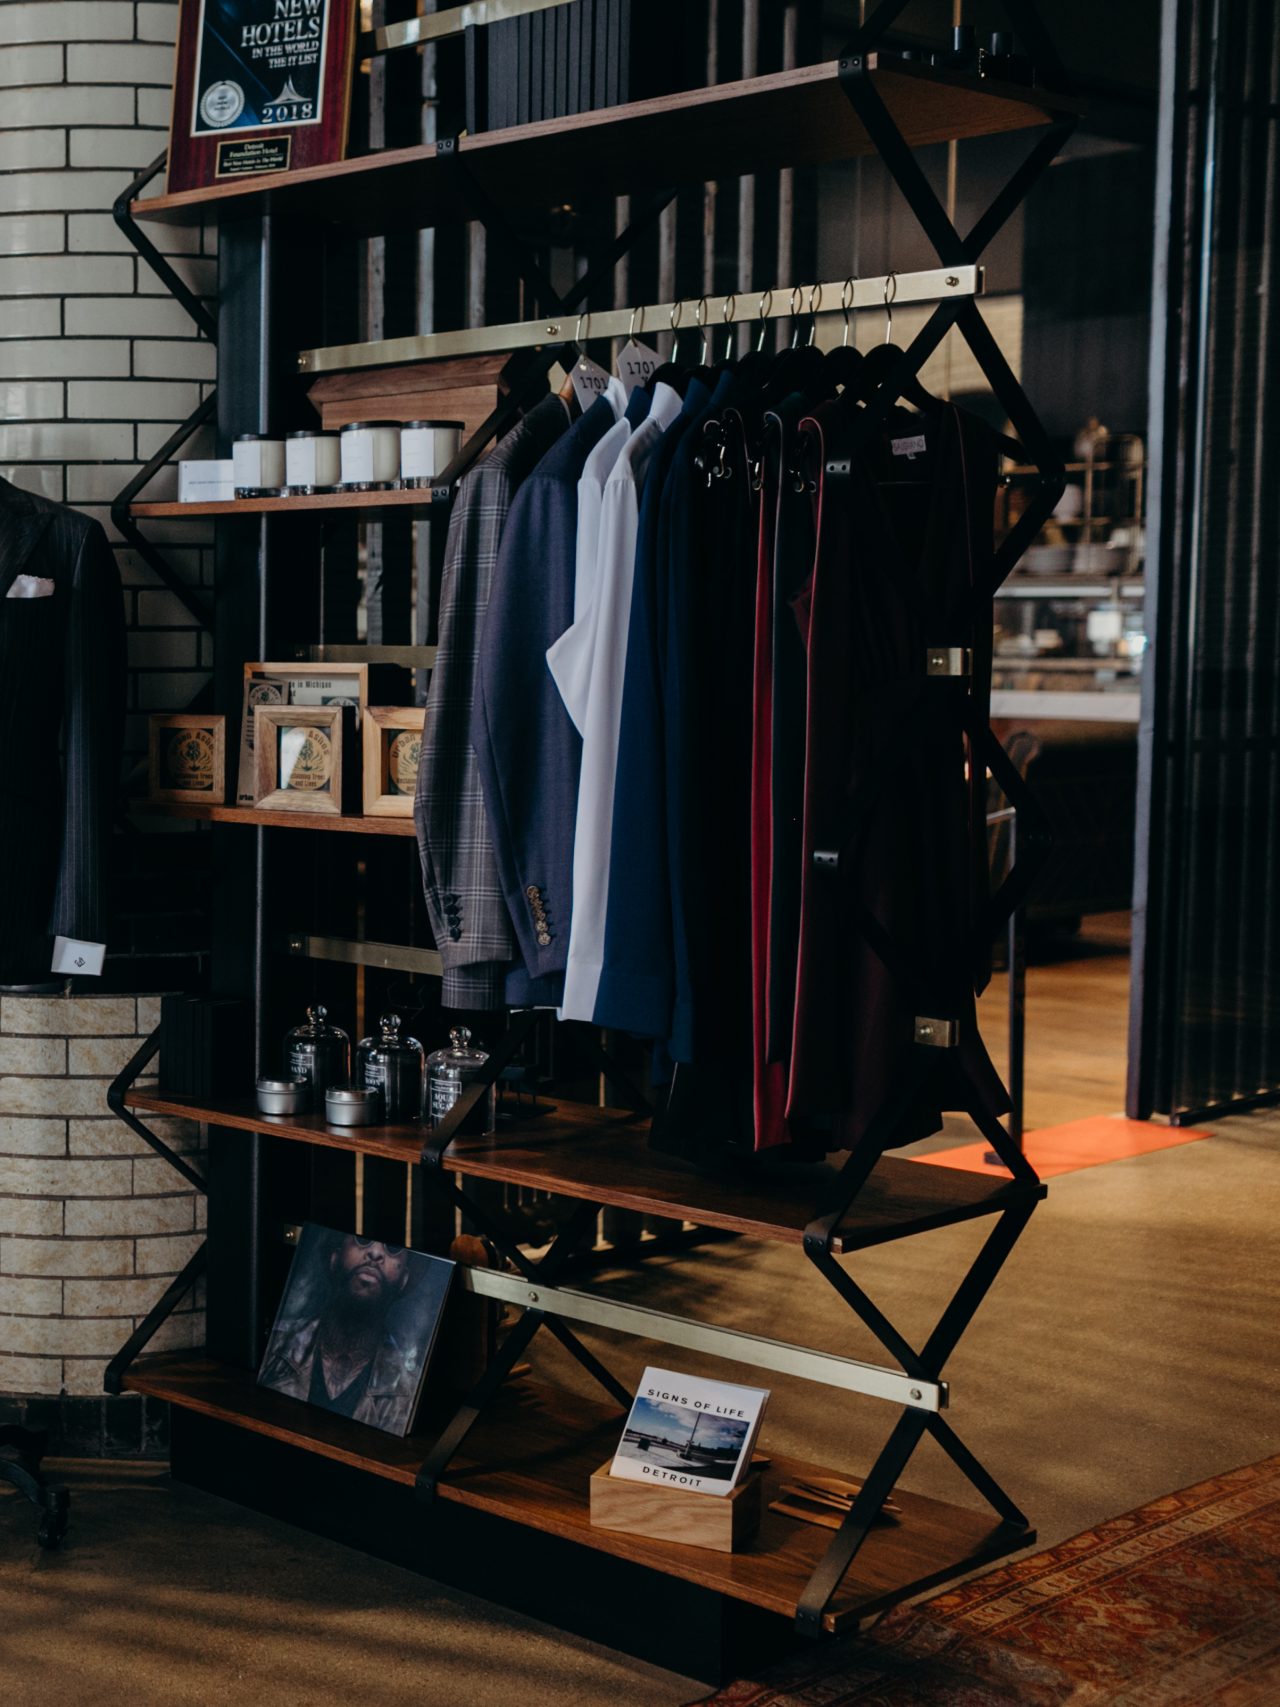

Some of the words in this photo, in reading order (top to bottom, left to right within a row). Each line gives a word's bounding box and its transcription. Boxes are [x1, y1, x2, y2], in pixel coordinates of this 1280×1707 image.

[274, 0, 321, 19] NEW
[242, 17, 320, 47] HOTELS
[252, 47, 264, 59] IN
[265, 45, 283, 57] THE
[285, 41, 321, 55] WORLD
[269, 57, 289, 69] THE
[289, 56, 298, 67] IT
[298, 54, 317, 65] LIST
[262, 104, 313, 123] 2018
[627, 360, 656, 375] 1701
[580, 376, 608, 390] 1701
[305, 681, 332, 689] Michigan
[648, 1389, 688, 1404] SIGNS
[694, 1400, 711, 1410] OF
[716, 1406, 744, 1417] LIFE
[643, 1467, 701, 1486] DETROIT
